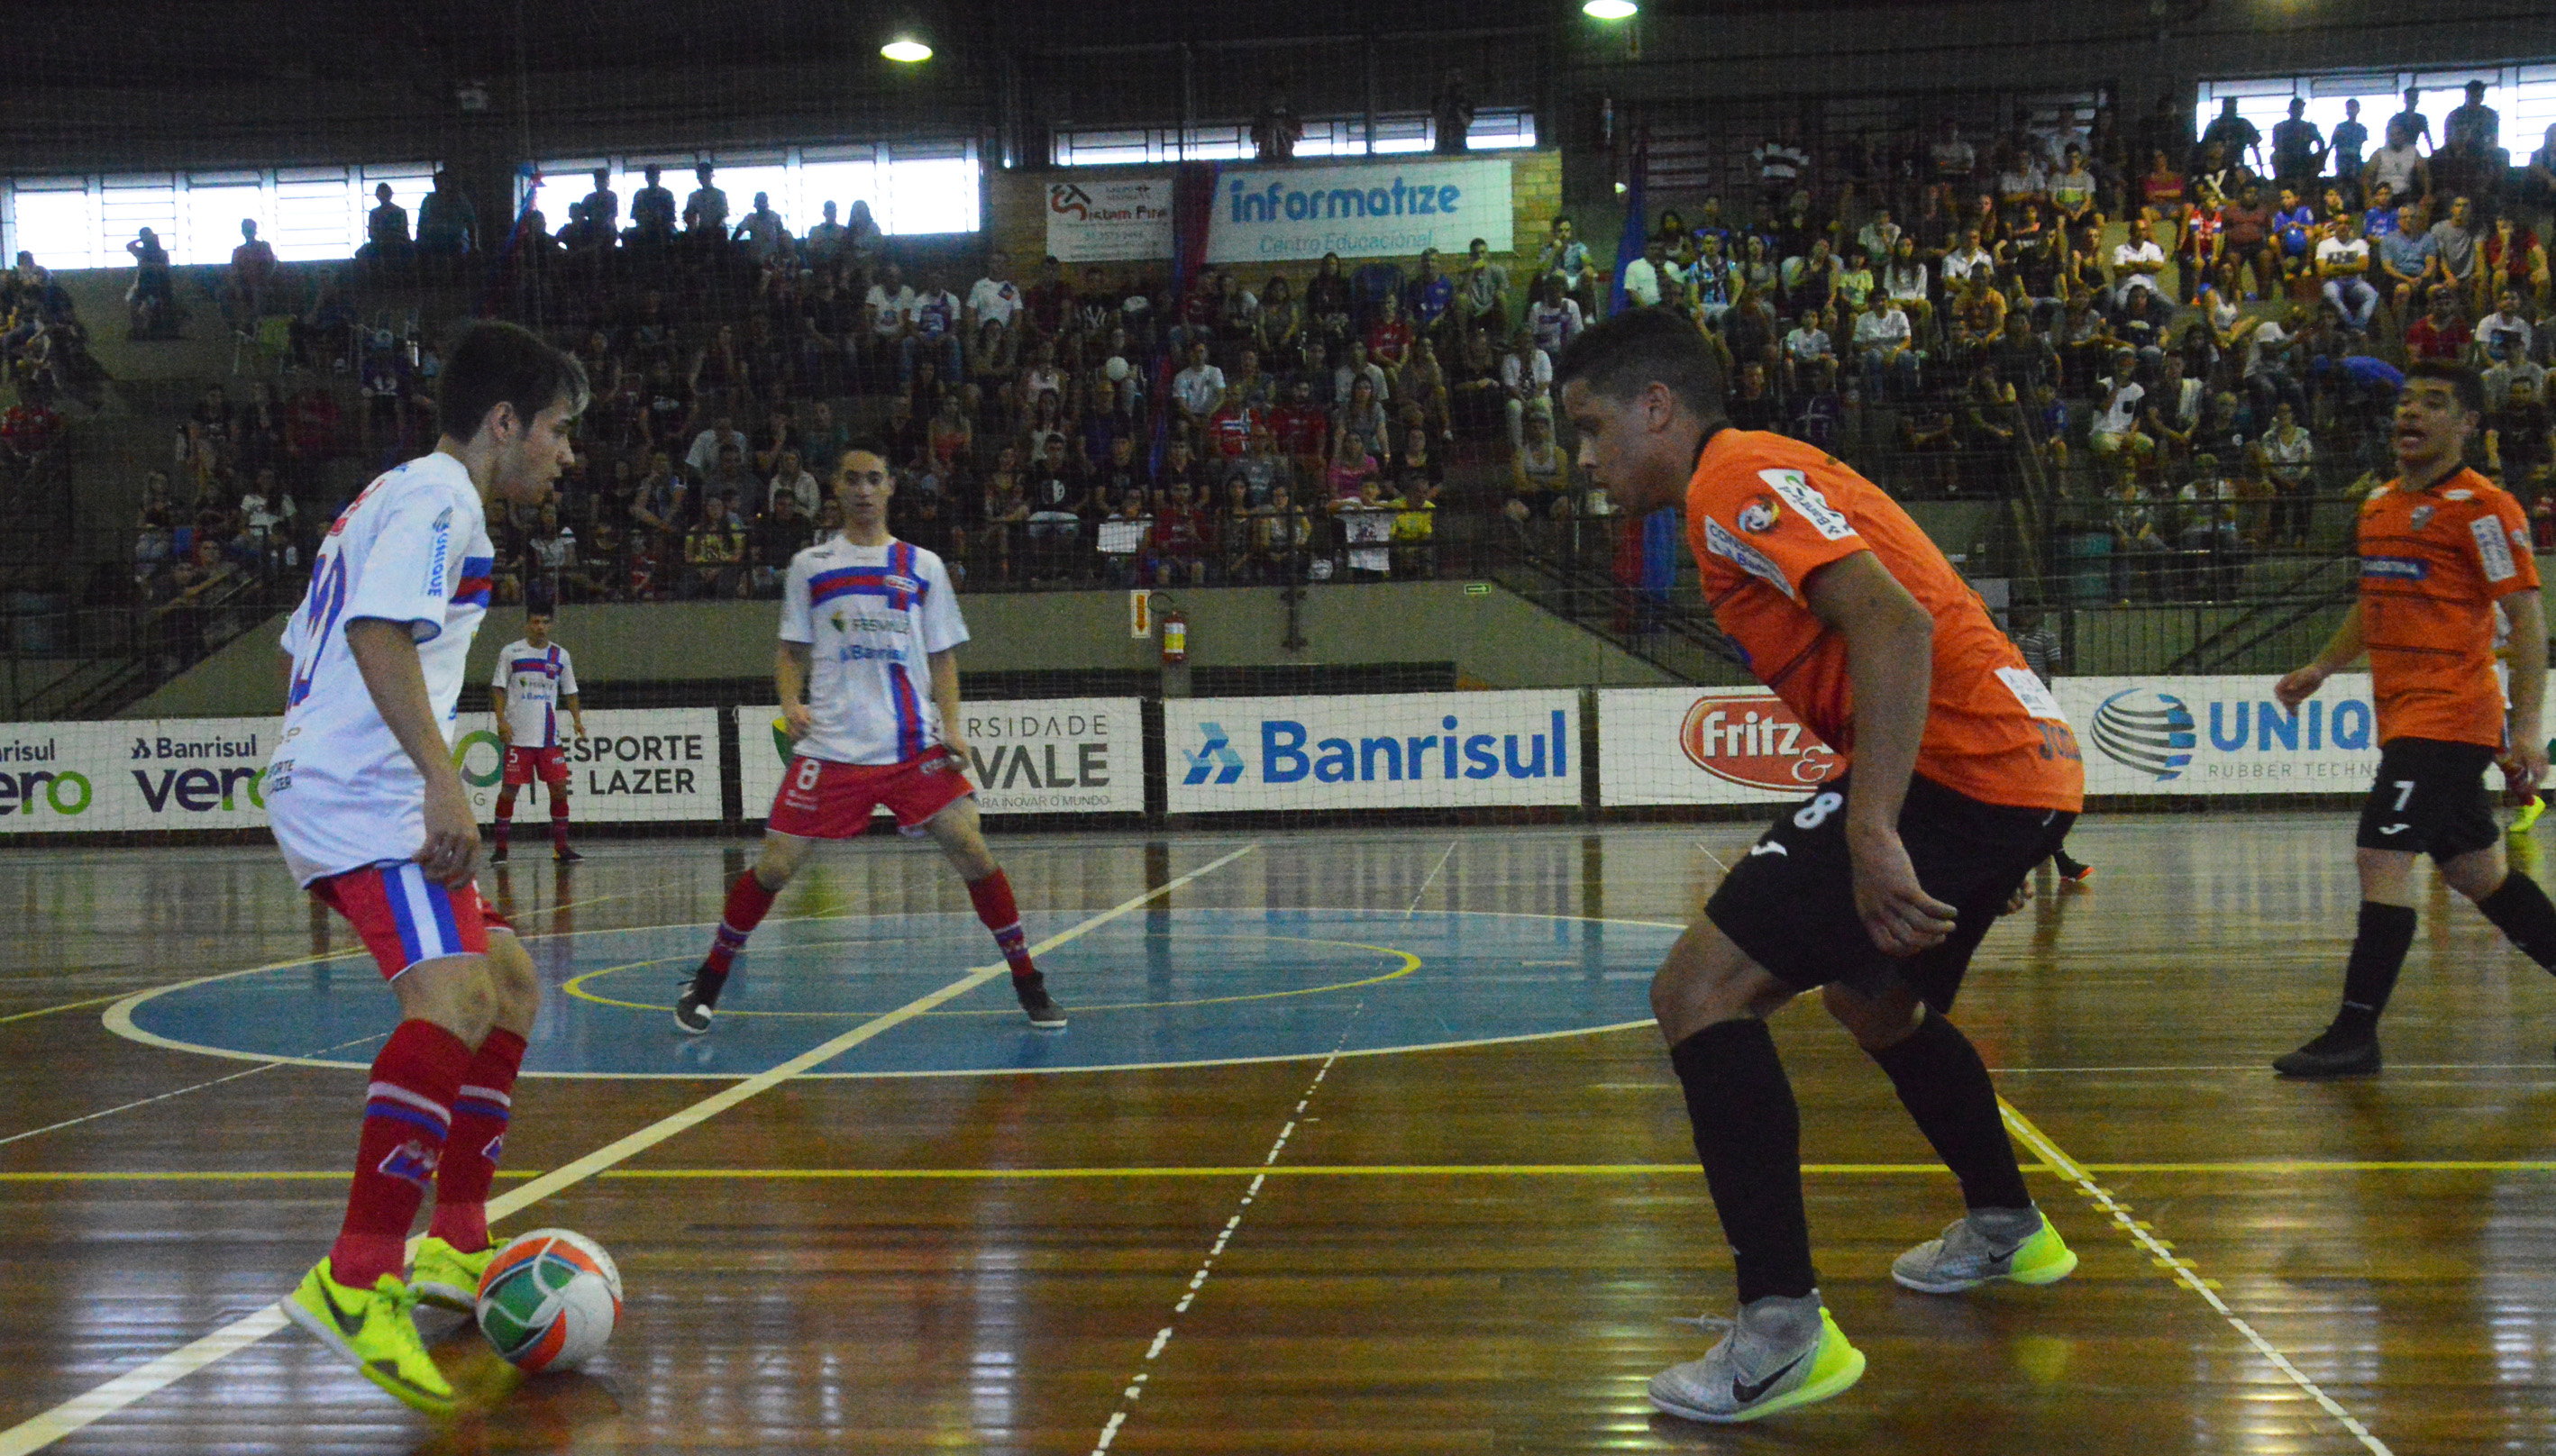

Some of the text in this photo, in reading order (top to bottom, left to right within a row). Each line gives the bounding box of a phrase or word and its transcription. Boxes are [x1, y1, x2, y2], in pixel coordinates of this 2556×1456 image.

[1229, 177, 1461, 223] informatize
[1260, 230, 1434, 254] Centro Educacional
[428, 532, 449, 596] UNIQUE
[967, 714, 1108, 738] RSIDADE
[1702, 711, 1802, 757] Fritz
[2210, 699, 2371, 752] UNIQ
[156, 733, 257, 760] Banrisul
[508, 749, 519, 764] 5
[1261, 709, 1566, 784] Banrisul
[589, 769, 696, 796] LAZER
[797, 759, 822, 790] 8
[2208, 764, 2292, 778] RUBBER
[1001, 796, 1046, 807] INOVAR
[1050, 796, 1059, 807] O
[1062, 795, 1110, 807] MUNDO
[1792, 791, 1844, 830] 8
[2393, 780, 2416, 811] 7
